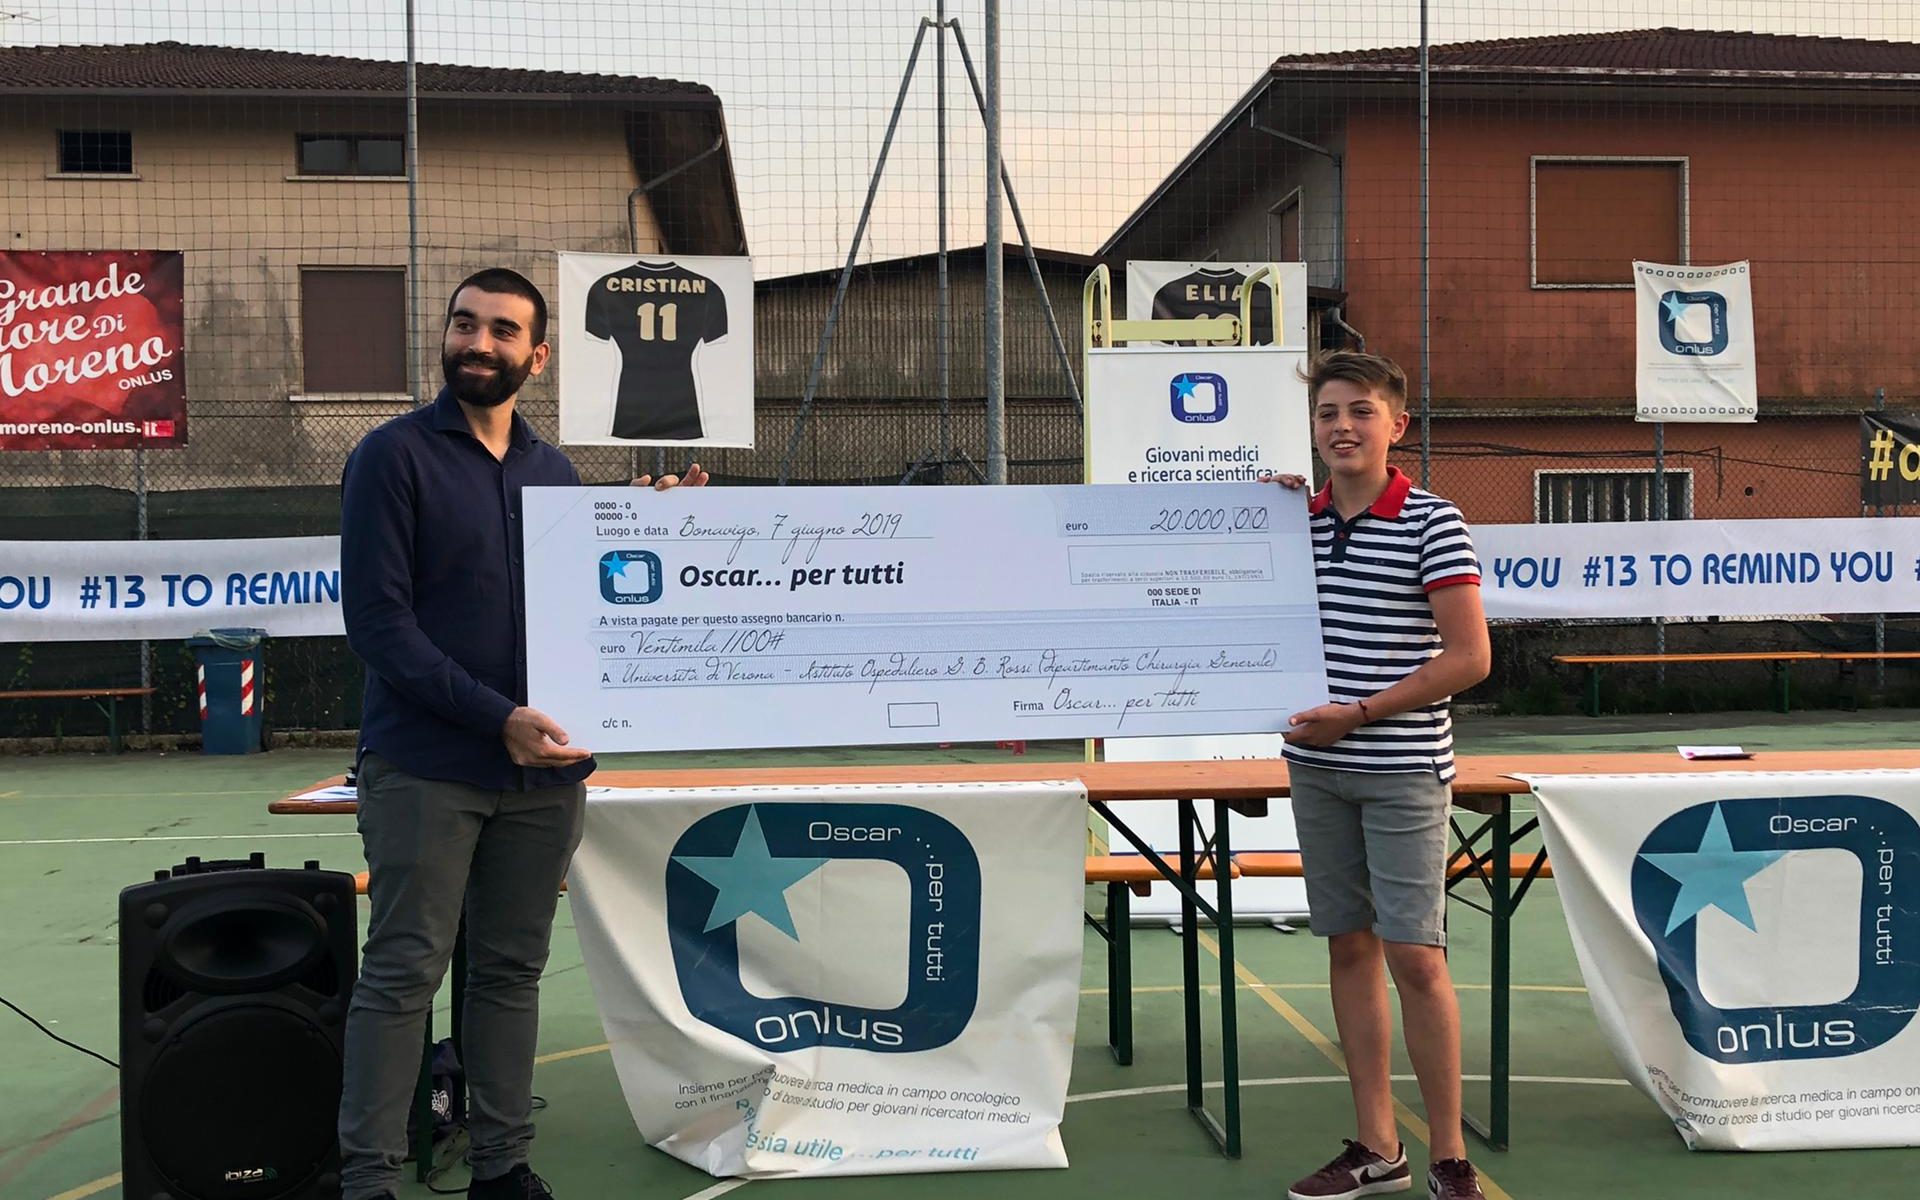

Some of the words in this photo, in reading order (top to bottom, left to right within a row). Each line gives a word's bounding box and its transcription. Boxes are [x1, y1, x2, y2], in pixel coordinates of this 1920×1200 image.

[606, 277, 706, 294] CRISTIAN
[93, 314, 127, 338] Di
[637, 302, 677, 341] 11
[1675, 344, 1714, 354] onlus
[119, 369, 173, 391] ONLUS
[1185, 414, 1217, 422] onlus
[1146, 446, 1204, 463] Giovani
[1208, 445, 1259, 462] medici
[1128, 470, 1137, 482] e
[1141, 466, 1192, 482] ricerca
[594, 502, 617, 510] 0000
[595, 512, 623, 521] 00000
[1065, 522, 1089, 531] euro
[596, 526, 631, 537] Luogo
[634, 529, 641, 537] e
[648, 525, 669, 536] data
[770, 514, 788, 540] 7
[781, 523, 845, 565] giugno
[852, 512, 903, 538] 2019
[680, 565, 781, 587] Oscar...
[790, 567, 836, 591] per
[842, 561, 904, 584] tutti
[1494, 557, 1560, 588] YOU
[1583, 555, 1638, 587] #13
[1650, 554, 1692, 586] TO
[1703, 552, 1820, 585] REMIND
[1831, 551, 1893, 583] YOU
[80, 576, 146, 609] #13
[161, 575, 213, 607] TO
[615, 595, 650, 603] onlus
[1147, 588, 1163, 596] 000
[600, 616, 608, 626] A
[612, 615, 637, 626] vista
[641, 613, 678, 627] pagate
[681, 614, 699, 626] per
[703, 613, 738, 627] questo
[741, 614, 783, 625] assegno
[786, 612, 832, 623] bancario
[835, 614, 845, 622] n.
[600, 644, 625, 653] euro
[602, 672, 610, 683] A
[705, 656, 720, 681] di
[722, 662, 775, 681] Verona
[799, 660, 854, 680] Istituto
[861, 652, 938, 694] Ospedaliero
[996, 655, 1033, 678] Rossi
[1136, 648, 1200, 692] Chirurgia
[1206, 649, 1277, 669] Generale)
[1013, 700, 1044, 711] Firma
[1054, 688, 1116, 710] Oscar...
[1117, 699, 1153, 729] per
[602, 717, 618, 728] c/c
[622, 719, 632, 728] n.
[1769, 815, 1858, 834] Oscar
[1876, 904, 1895, 965] tutti
[809, 822, 902, 841] Oscar
[925, 921, 945, 982] tutti
[755, 1007, 904, 1045] onlus
[1717, 1013, 1856, 1054] onlus
[679, 1082, 725, 1094] Insieme
[728, 1076, 748, 1088] per
[836, 1080, 884, 1096] medica
[887, 1084, 898, 1097] in
[902, 1086, 947, 1102] campo
[950, 1090, 1021, 1108] oncologico
[1681, 1092, 1749, 1109] promuovere
[1800, 1089, 1843, 1103] medica
[1847, 1088, 1857, 1100] in
[1860, 1087, 1902, 1100] campo
[675, 1100, 698, 1110] con
[846, 1101, 869, 1114] per
[872, 1103, 918, 1117] giovani
[921, 1106, 984, 1121] ricercatori
[987, 1112, 1030, 1125] medici
[1719, 1114, 1729, 1126] di
[1731, 1113, 1758, 1125] borse
[1761, 1111, 1772, 1123] di
[1775, 1109, 1812, 1121] studio
[1815, 1109, 1834, 1122] per
[1838, 1105, 1879, 1120] giovani
[794, 1138, 843, 1161] utile
[928, 1147, 980, 1161] tutti
